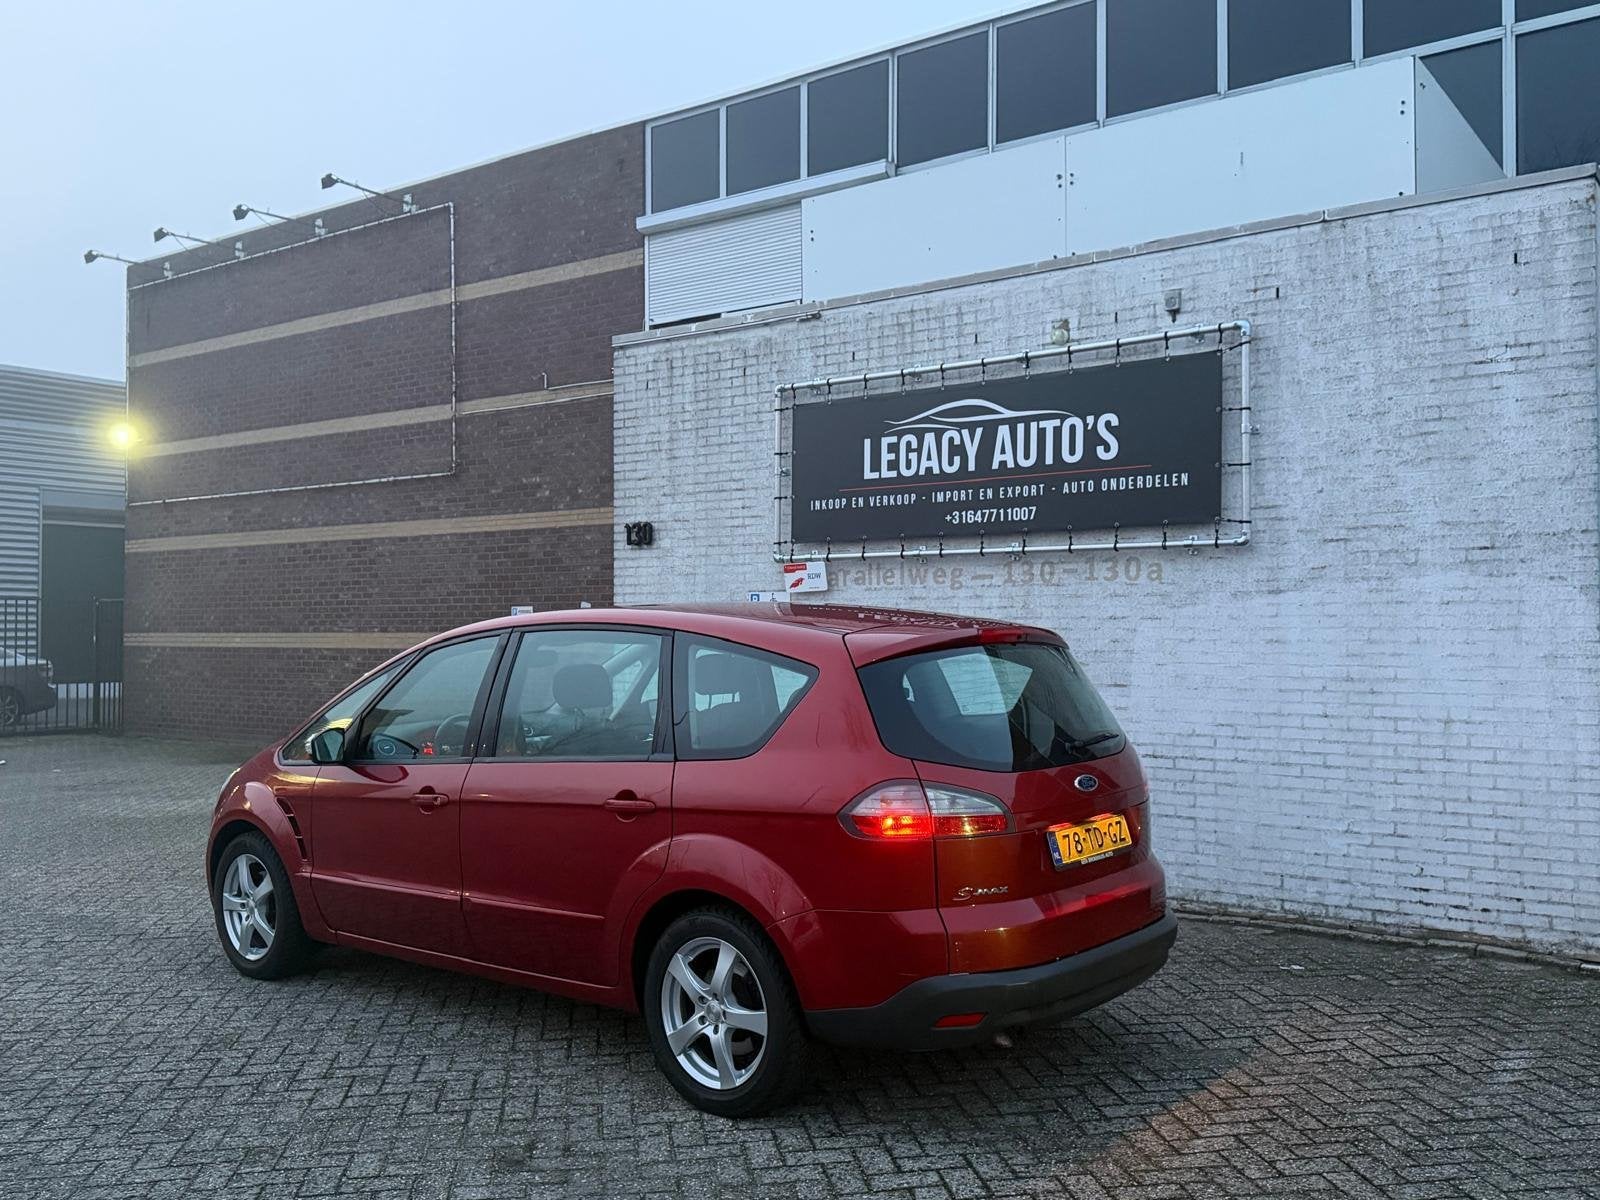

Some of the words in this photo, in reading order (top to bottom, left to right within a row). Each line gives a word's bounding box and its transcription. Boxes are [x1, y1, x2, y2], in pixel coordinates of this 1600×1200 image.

[863, 427, 983, 480] LEGACY
[991, 413, 1119, 470] AUTO'S
[810, 499, 847, 511] INKOOP
[851, 497, 864, 508] EN
[869, 494, 917, 506] VERKOOP
[931, 489, 973, 503] IMPORT
[979, 488, 993, 500] EN
[1000, 484, 1045, 499] EXPORT
[1062, 480, 1094, 494] AUTO
[1101, 472, 1189, 491] ONDERDELEN
[944, 506, 1037, 524] +31647711007
[624, 521, 653, 546] 130
[827, 562, 964, 591] arallelweg
[1062, 820, 1126, 858] 78-TD-GZ
